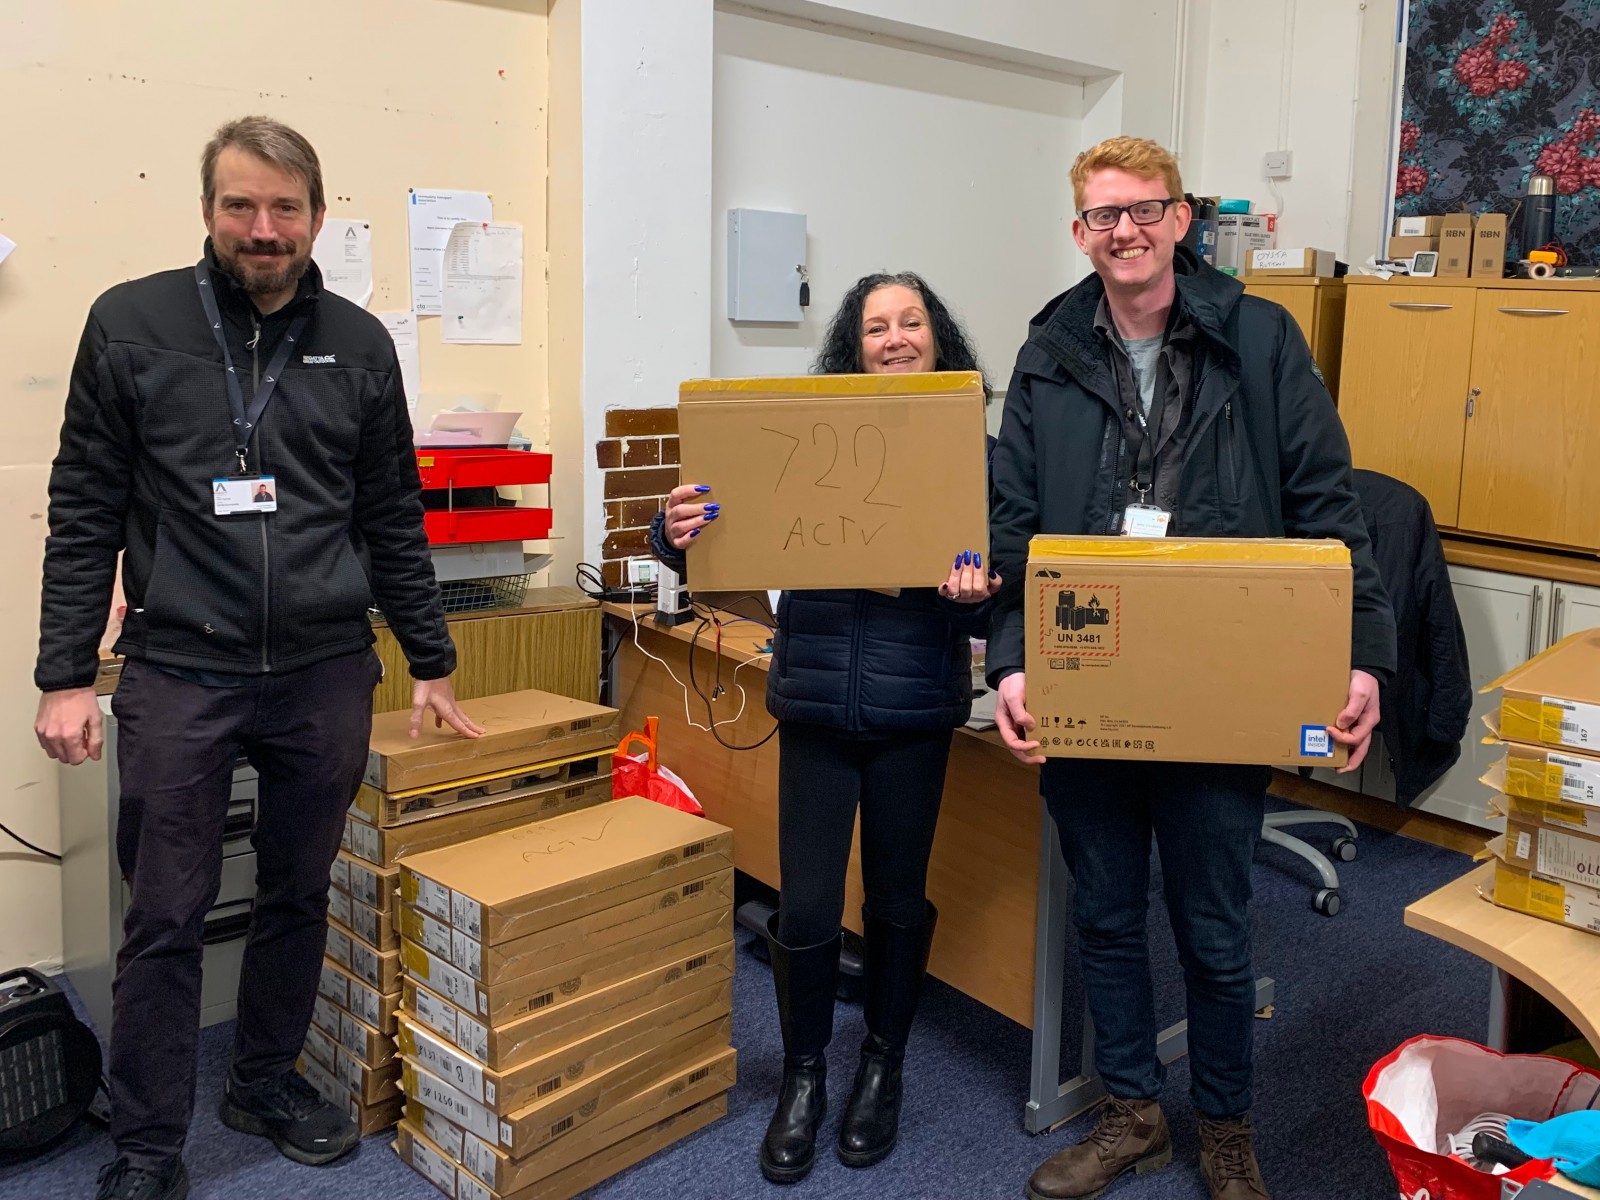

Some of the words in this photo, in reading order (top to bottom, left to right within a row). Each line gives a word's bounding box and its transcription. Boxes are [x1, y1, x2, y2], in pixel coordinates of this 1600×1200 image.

[761, 422, 902, 509] 722
[783, 515, 888, 550] ACTV
[1057, 633, 1074, 643] UN
[1076, 634, 1101, 643] 3481
[1308, 734, 1326, 742] intel
[1580, 728, 1588, 742] 167
[1586, 785, 1594, 799] 124
